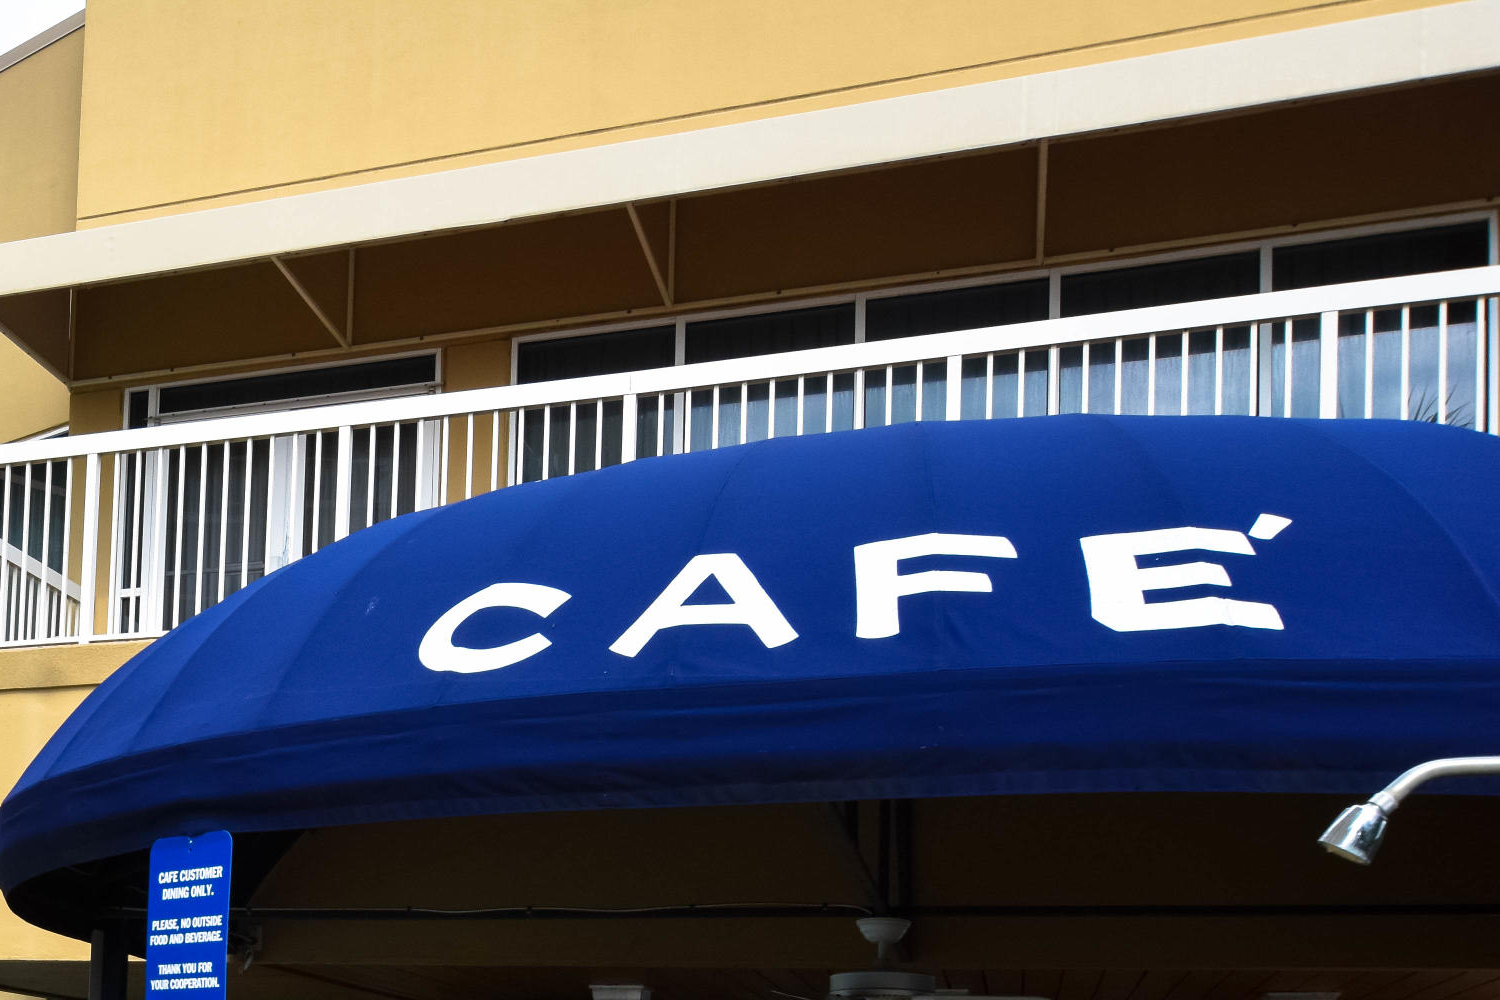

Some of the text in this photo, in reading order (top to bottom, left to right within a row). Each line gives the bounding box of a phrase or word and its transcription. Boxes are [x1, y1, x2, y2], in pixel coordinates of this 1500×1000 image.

[419, 513, 1293, 673] CAFÉ
[158, 866, 223, 884] CAFE CUSTOMER
[162, 884, 214, 900] DINING ONLY.
[152, 915, 222, 931] PLEASE, NO OUTSIDE
[150, 930, 223, 946] FOOD AND BEVERAGE.
[158, 962, 212, 975] THANK YOU FOR
[151, 977, 220, 990] YOUR COOPERATION.
